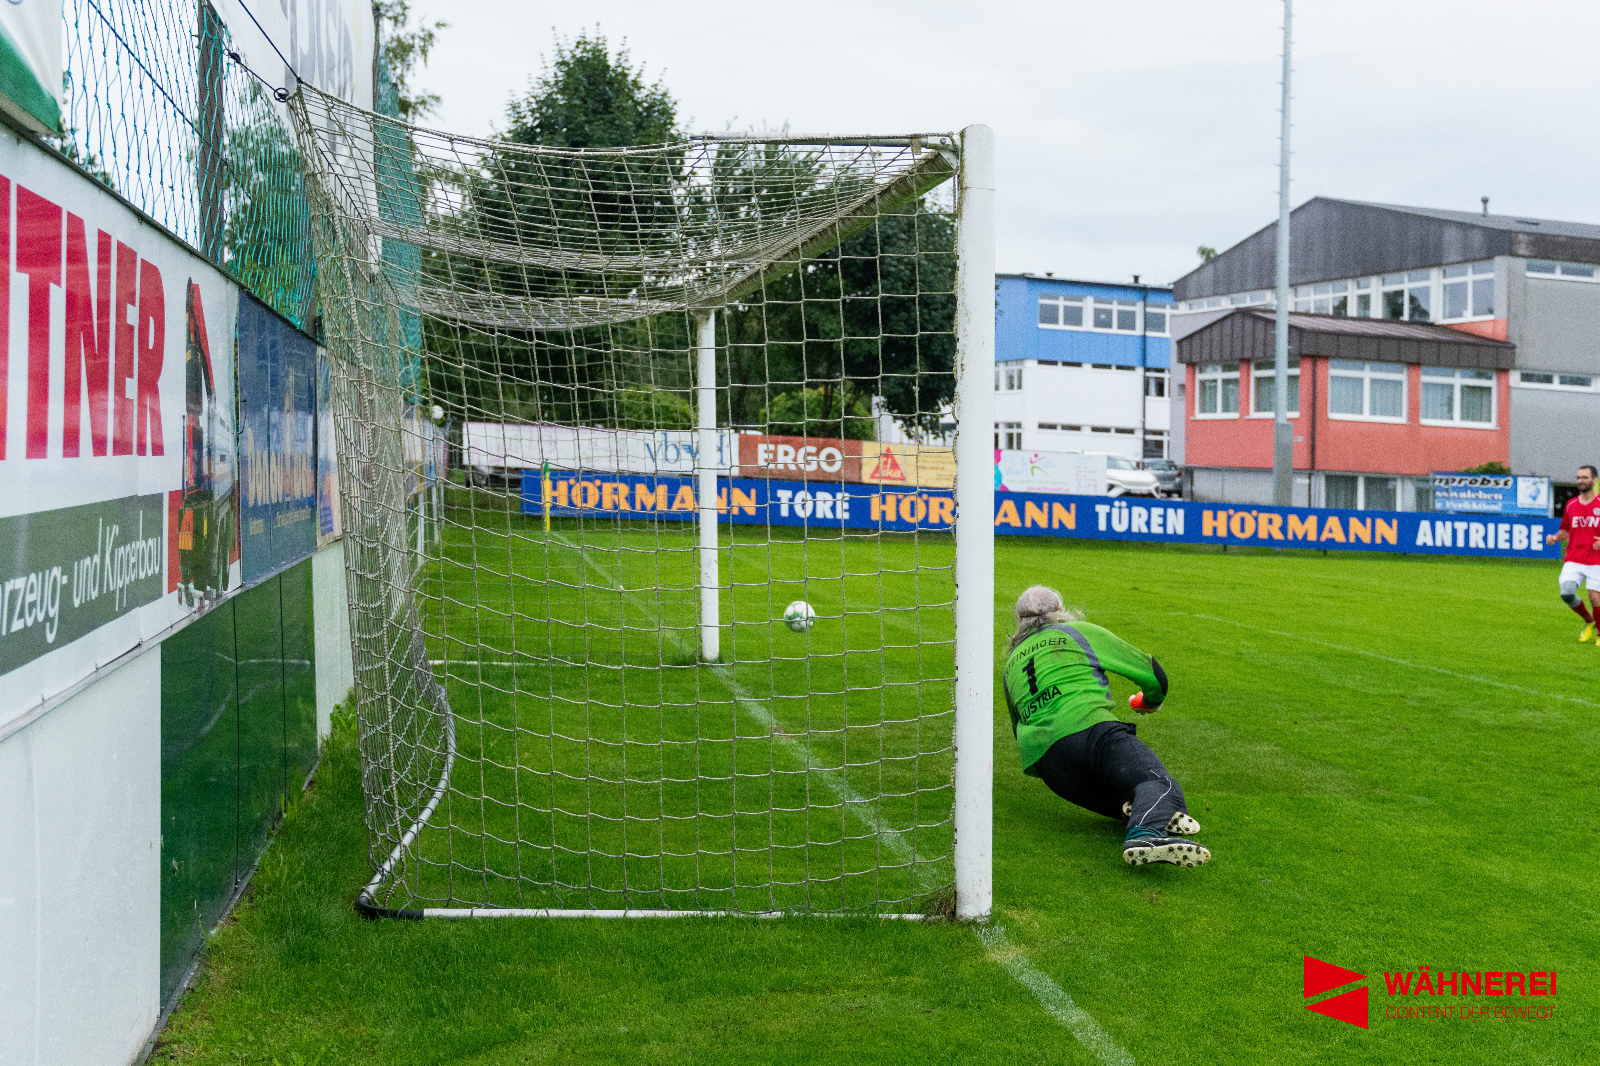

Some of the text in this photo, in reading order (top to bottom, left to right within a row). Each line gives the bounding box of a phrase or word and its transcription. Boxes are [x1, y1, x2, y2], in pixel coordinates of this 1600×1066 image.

[757, 443, 843, 473] ERGO
[777, 489, 850, 520] TORE
[870, 493, 1076, 530] HÖRANN
[1095, 501, 1185, 535] TÜREN
[1202, 508, 1398, 546] HÖRMANN
[1416, 519, 1544, 551] ANTRIEBE
[1571, 515, 1600, 528] EVN
[0, 509, 161, 643] rzeug- und Kipperbau
[1022, 656, 1039, 696] 1
